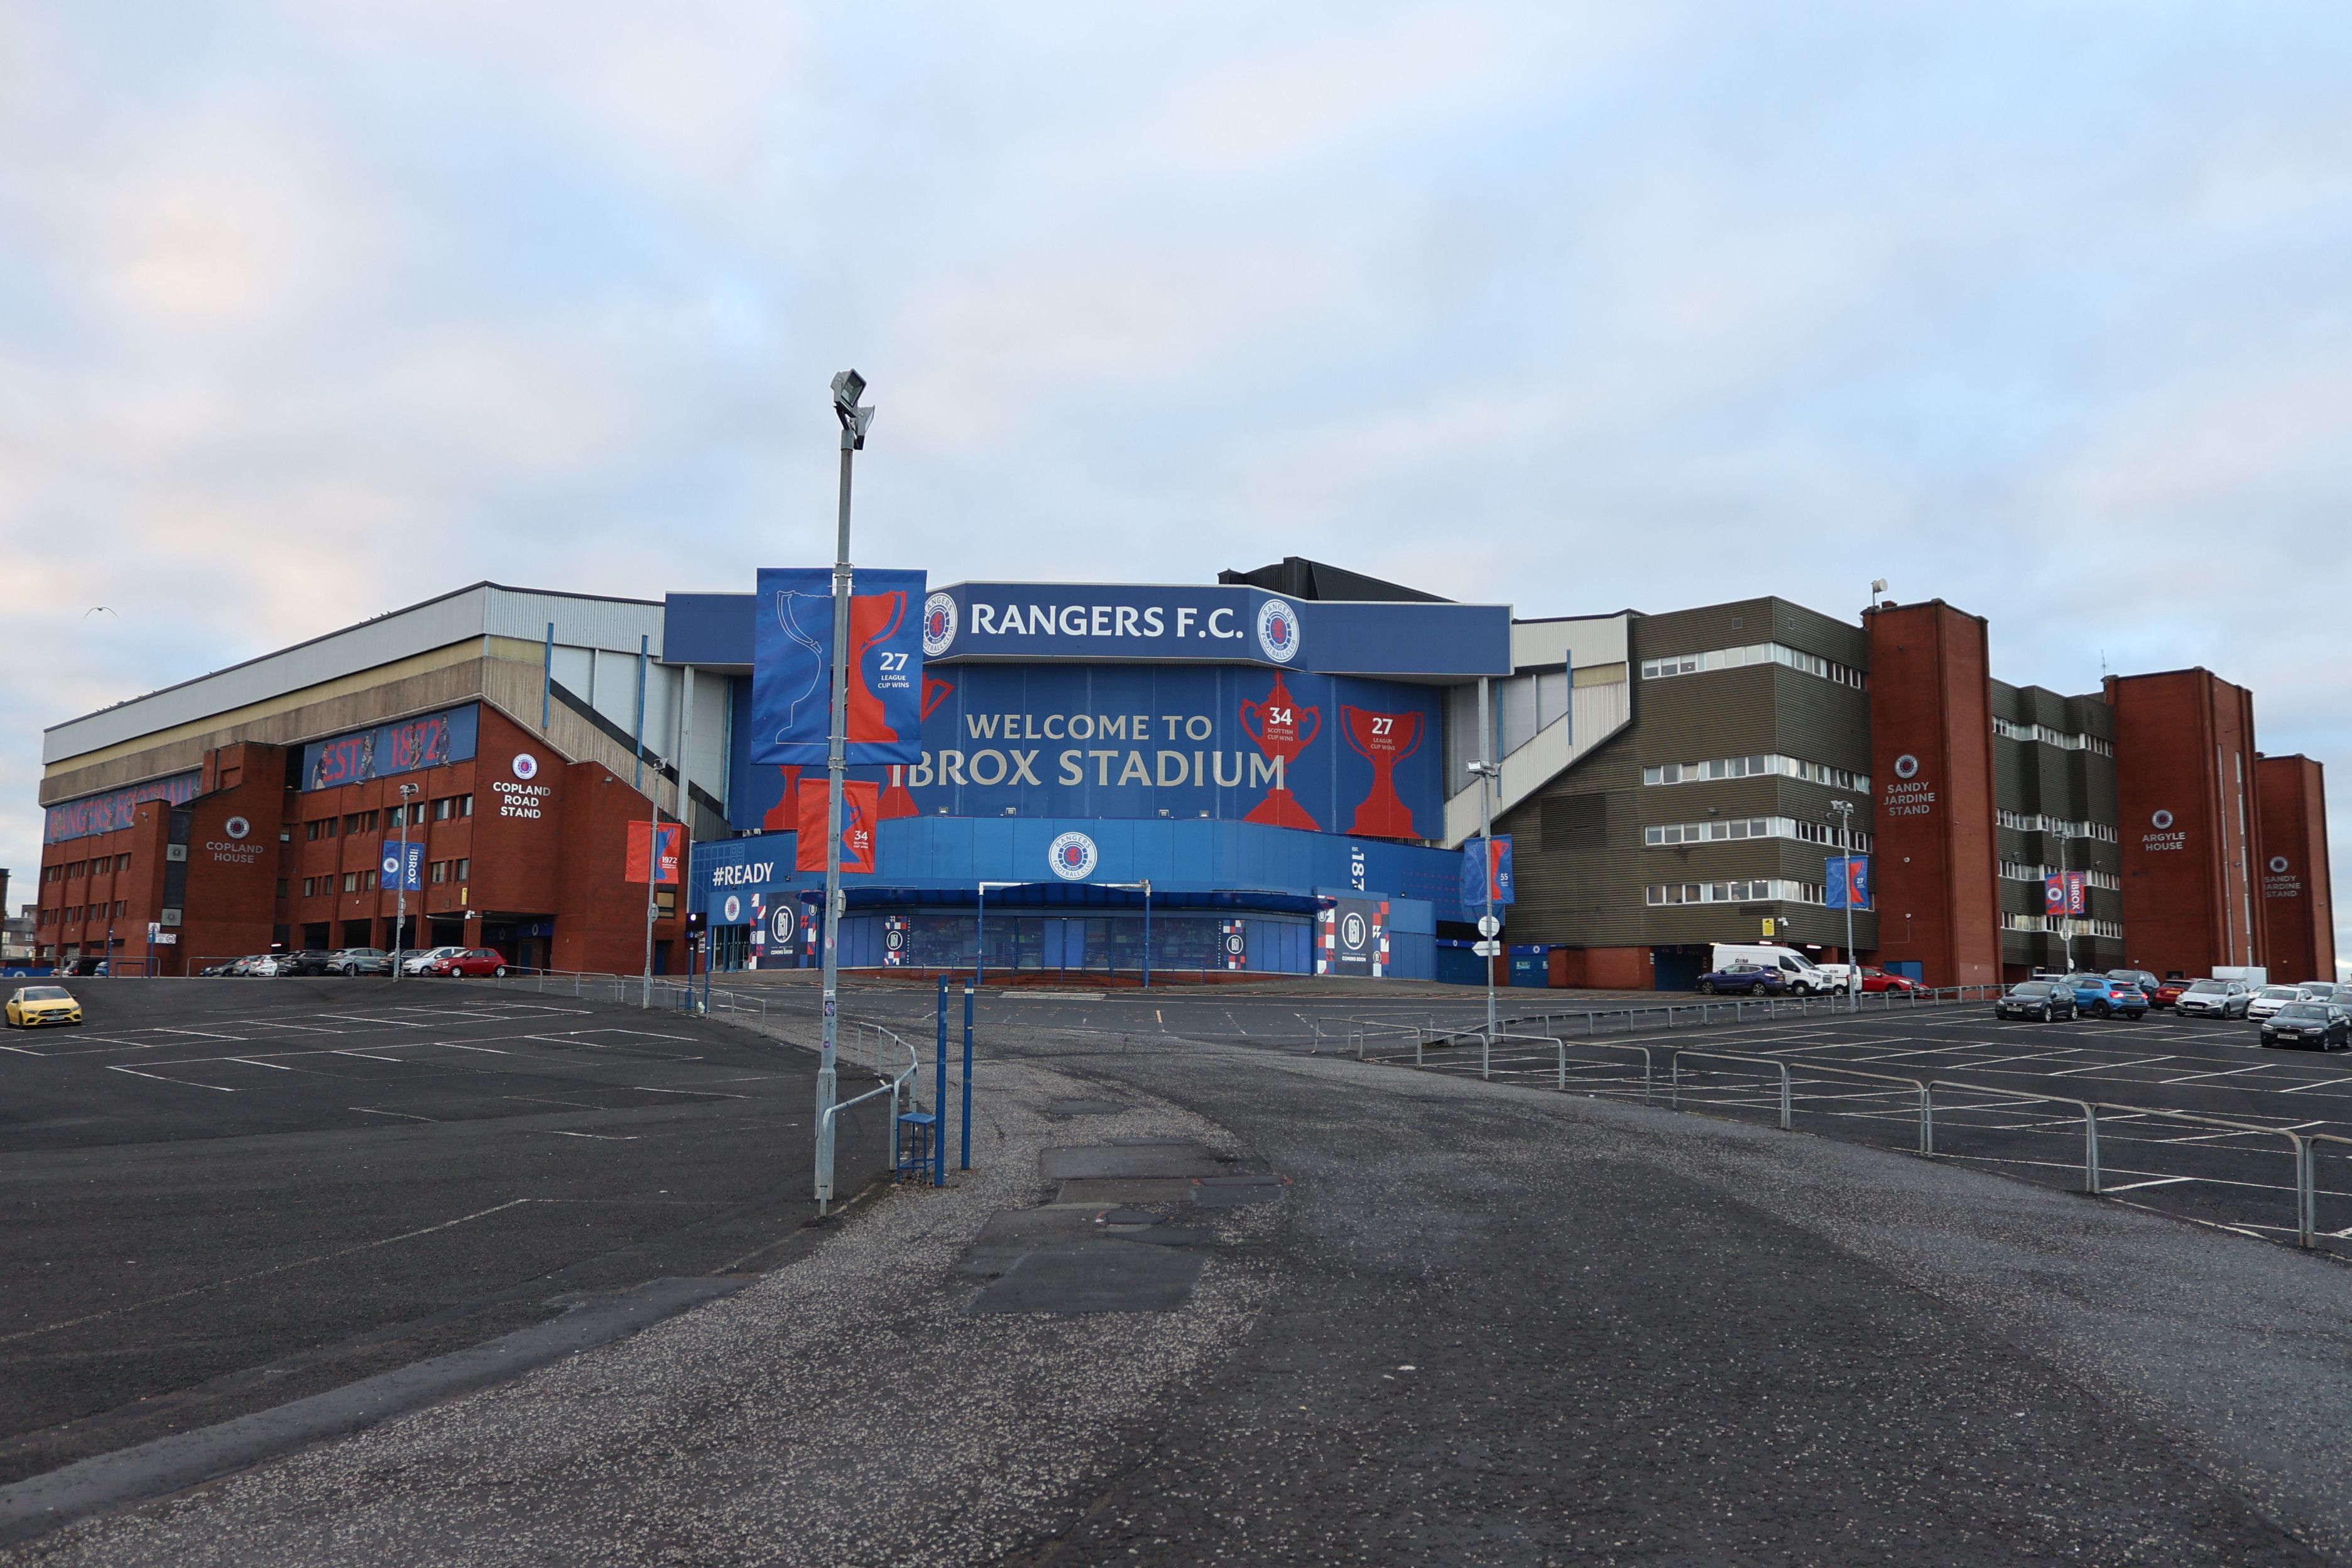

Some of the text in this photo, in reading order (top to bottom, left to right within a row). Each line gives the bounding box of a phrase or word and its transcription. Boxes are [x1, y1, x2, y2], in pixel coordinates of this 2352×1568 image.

[925, 597, 953, 614] ANGERS
[1263, 603, 1295, 624] RANGERS
[971, 604, 1244, 638] RANGERS F.C.
[923, 637, 944, 651] OTBALL
[1261, 632, 1286, 658] FOOTBALL
[879, 651, 909, 671] 27
[1270, 707, 1293, 726] 34
[966, 714, 1212, 741] WELCOME TO
[1371, 717, 1393, 735] 27
[391, 719, 441, 768] 1872
[892, 749, 1285, 790] IBROX STADIUM
[493, 781, 551, 797] COPLAND
[1887, 781, 1929, 793] SANDY
[504, 795, 539, 807] ROAD
[1883, 792, 1936, 805] JARDINE
[49, 797, 112, 839] RANGERS
[500, 806, 542, 819] STAND
[1889, 805, 1930, 816] STAND
[854, 830, 868, 841] 34
[1055, 835, 1092, 848] RANGERS
[2142, 832, 2186, 842] ARGYLE
[206, 842, 263, 854] COPLAND
[2145, 842, 2184, 851] HOUSE
[214, 852, 254, 863] HOUSE
[407, 851, 419, 885] IBROX
[712, 862, 774, 886] #READY
[1053, 859, 1093, 877] FOOTBALL CLUB
[2265, 874, 2297, 883] SANDY
[2071, 881, 2081, 910] IBROX
[1348, 918, 1360, 944] G51
